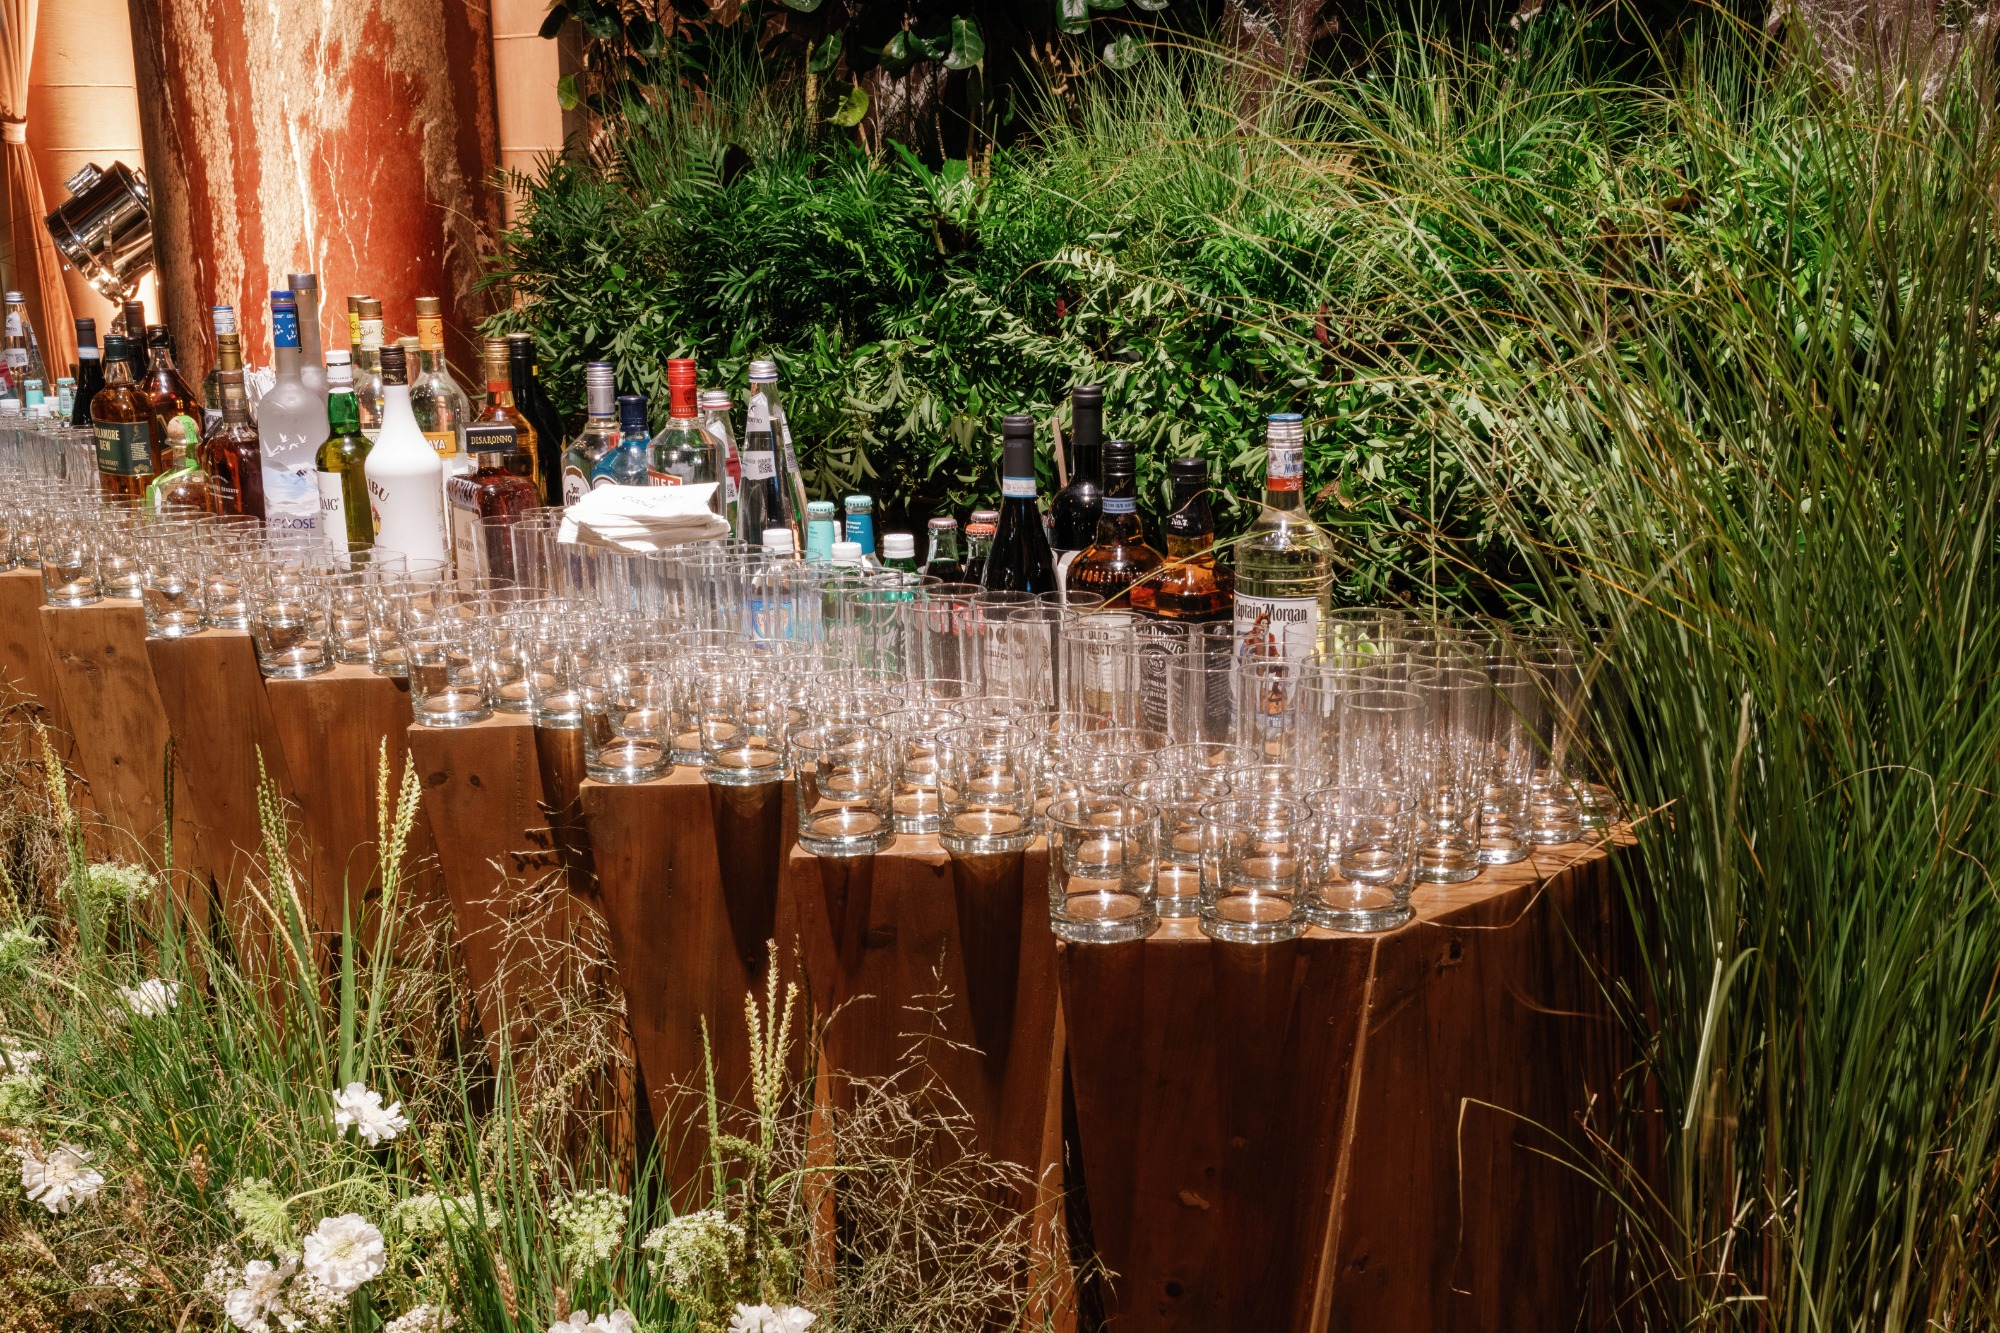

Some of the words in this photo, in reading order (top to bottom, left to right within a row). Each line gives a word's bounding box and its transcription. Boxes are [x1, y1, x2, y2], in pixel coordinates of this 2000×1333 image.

[470, 434, 513, 446] DISARONNO
[1234, 600, 1262, 622] Captain
[1263, 603, 1308, 623] Morgan
